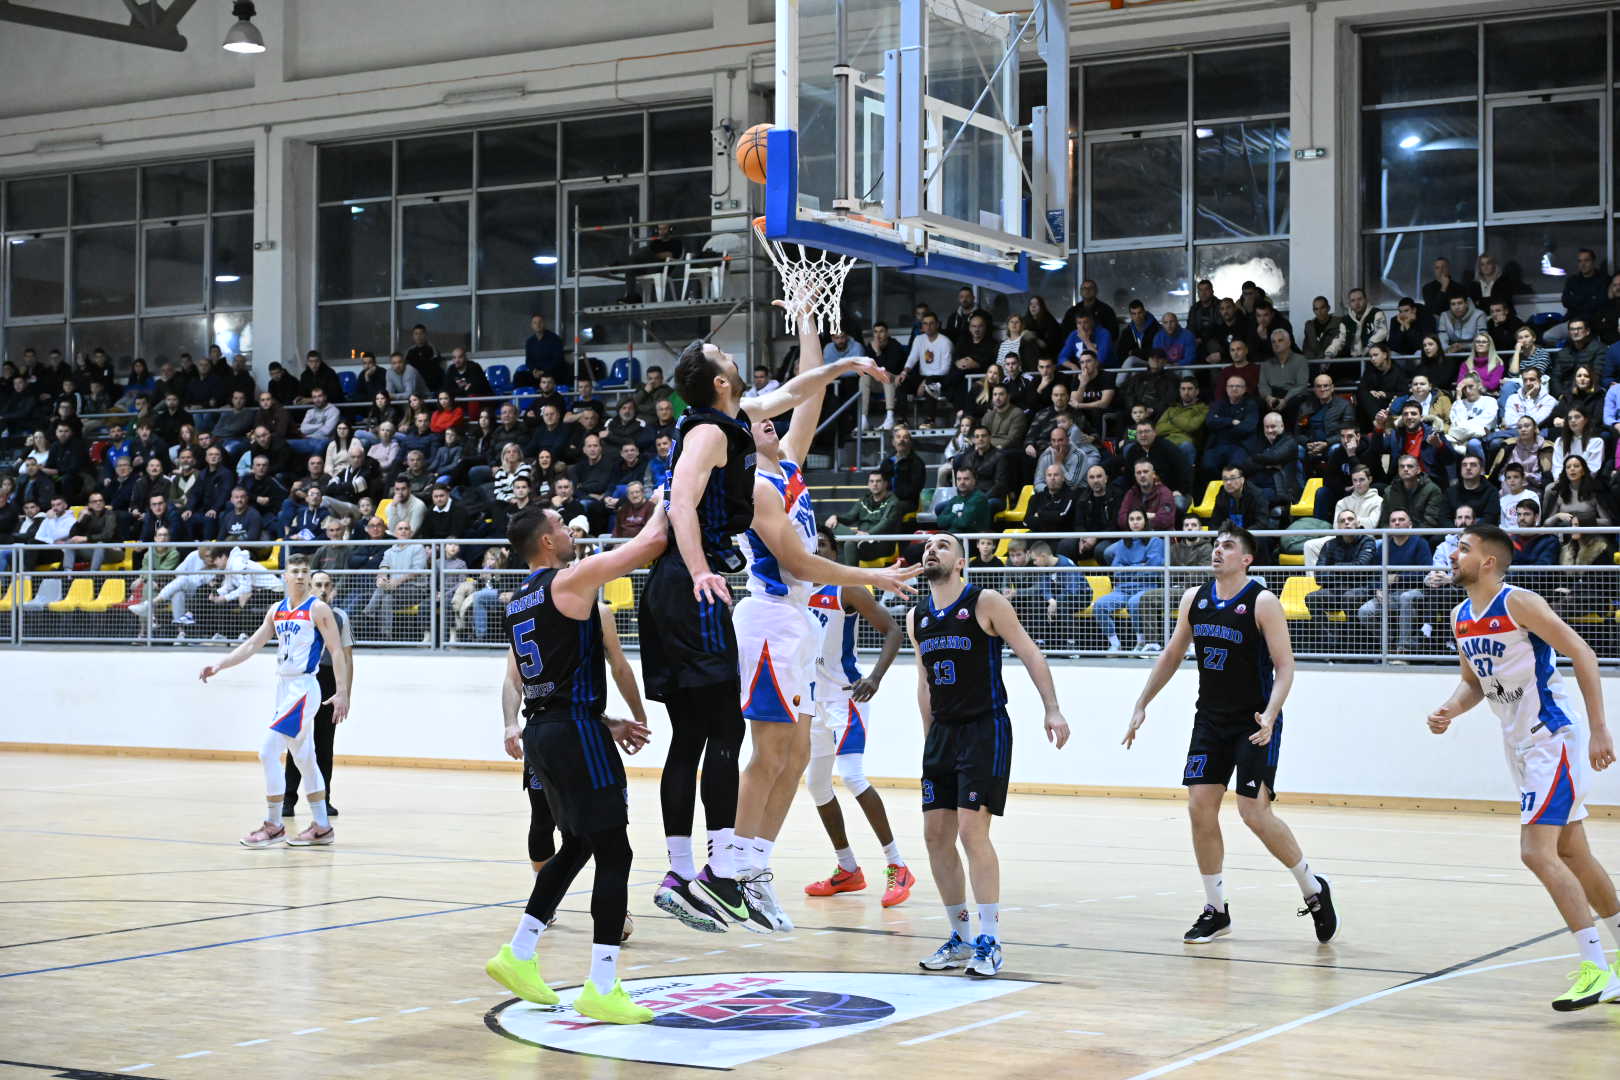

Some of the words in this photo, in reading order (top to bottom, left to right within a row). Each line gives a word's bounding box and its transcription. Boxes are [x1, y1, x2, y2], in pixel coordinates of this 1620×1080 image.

[920, 635, 971, 656] DINAMO
[1193, 624, 1243, 644] DINAMO
[512, 617, 544, 680] 5
[1203, 646, 1228, 671] 27
[933, 659, 956, 686] 13
[1473, 657, 1493, 678] 37
[1184, 754, 1208, 779] 27
